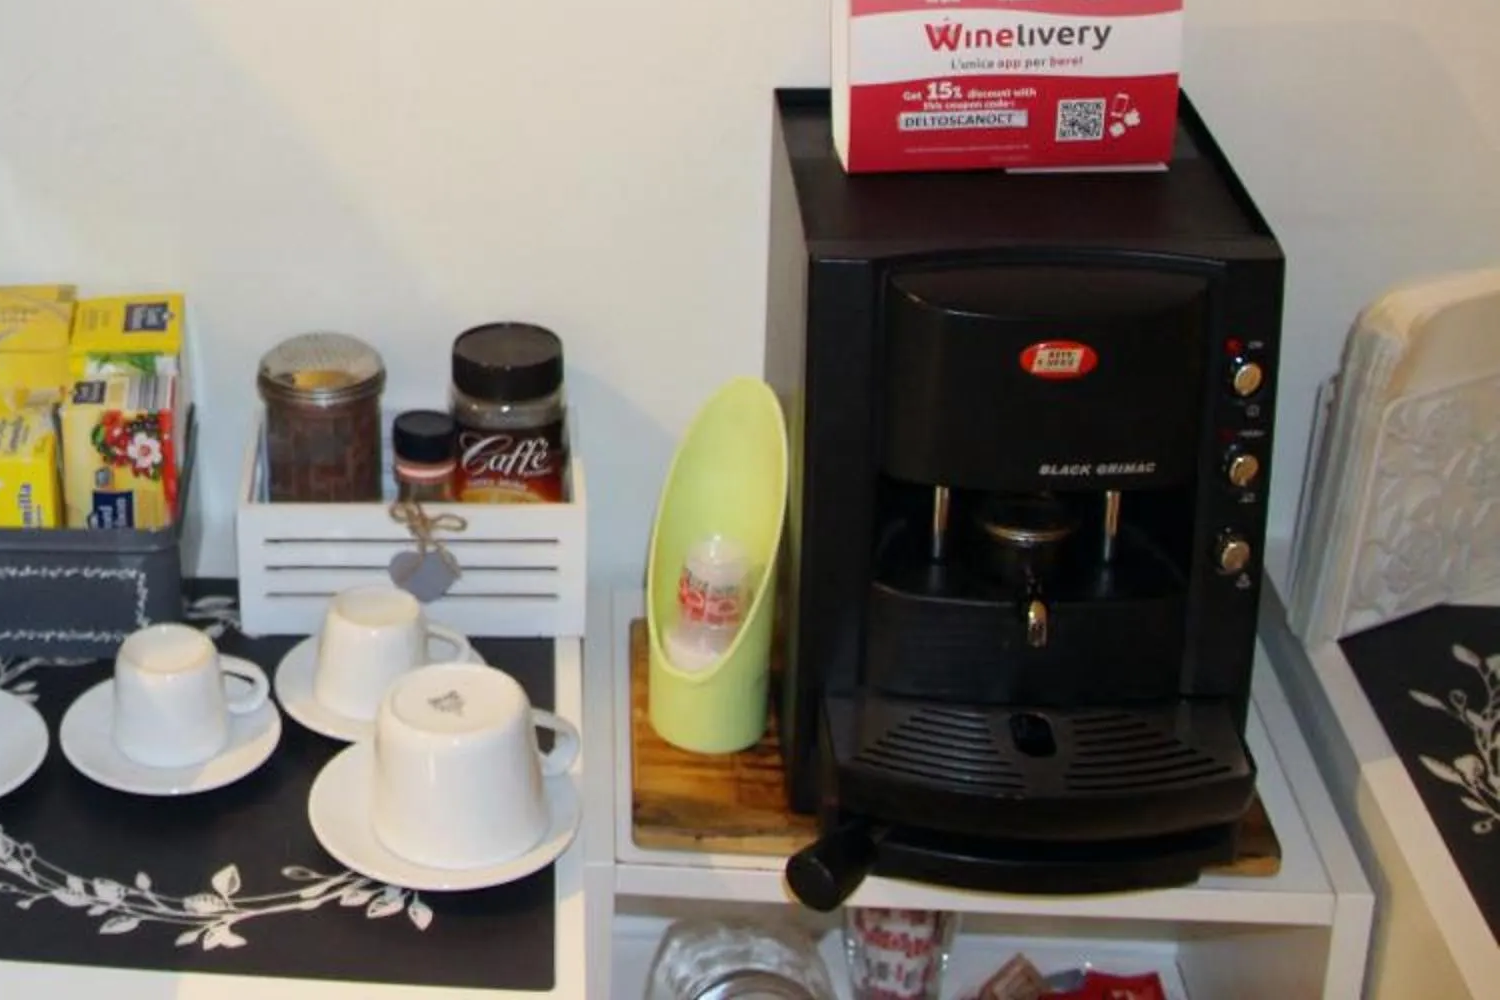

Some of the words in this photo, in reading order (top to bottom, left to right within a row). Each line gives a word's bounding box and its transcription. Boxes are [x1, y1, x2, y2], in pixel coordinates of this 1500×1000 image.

[924, 22, 1112, 52] Winelivery
[998, 58, 1021, 71] app
[1024, 58, 1046, 70] per
[1049, 56, 1083, 68] bere!
[903, 91, 922, 101] Get
[1013, 87, 1037, 97] with
[1038, 463, 1092, 476] BLACK
[1096, 461, 1157, 476] GRIMAC
